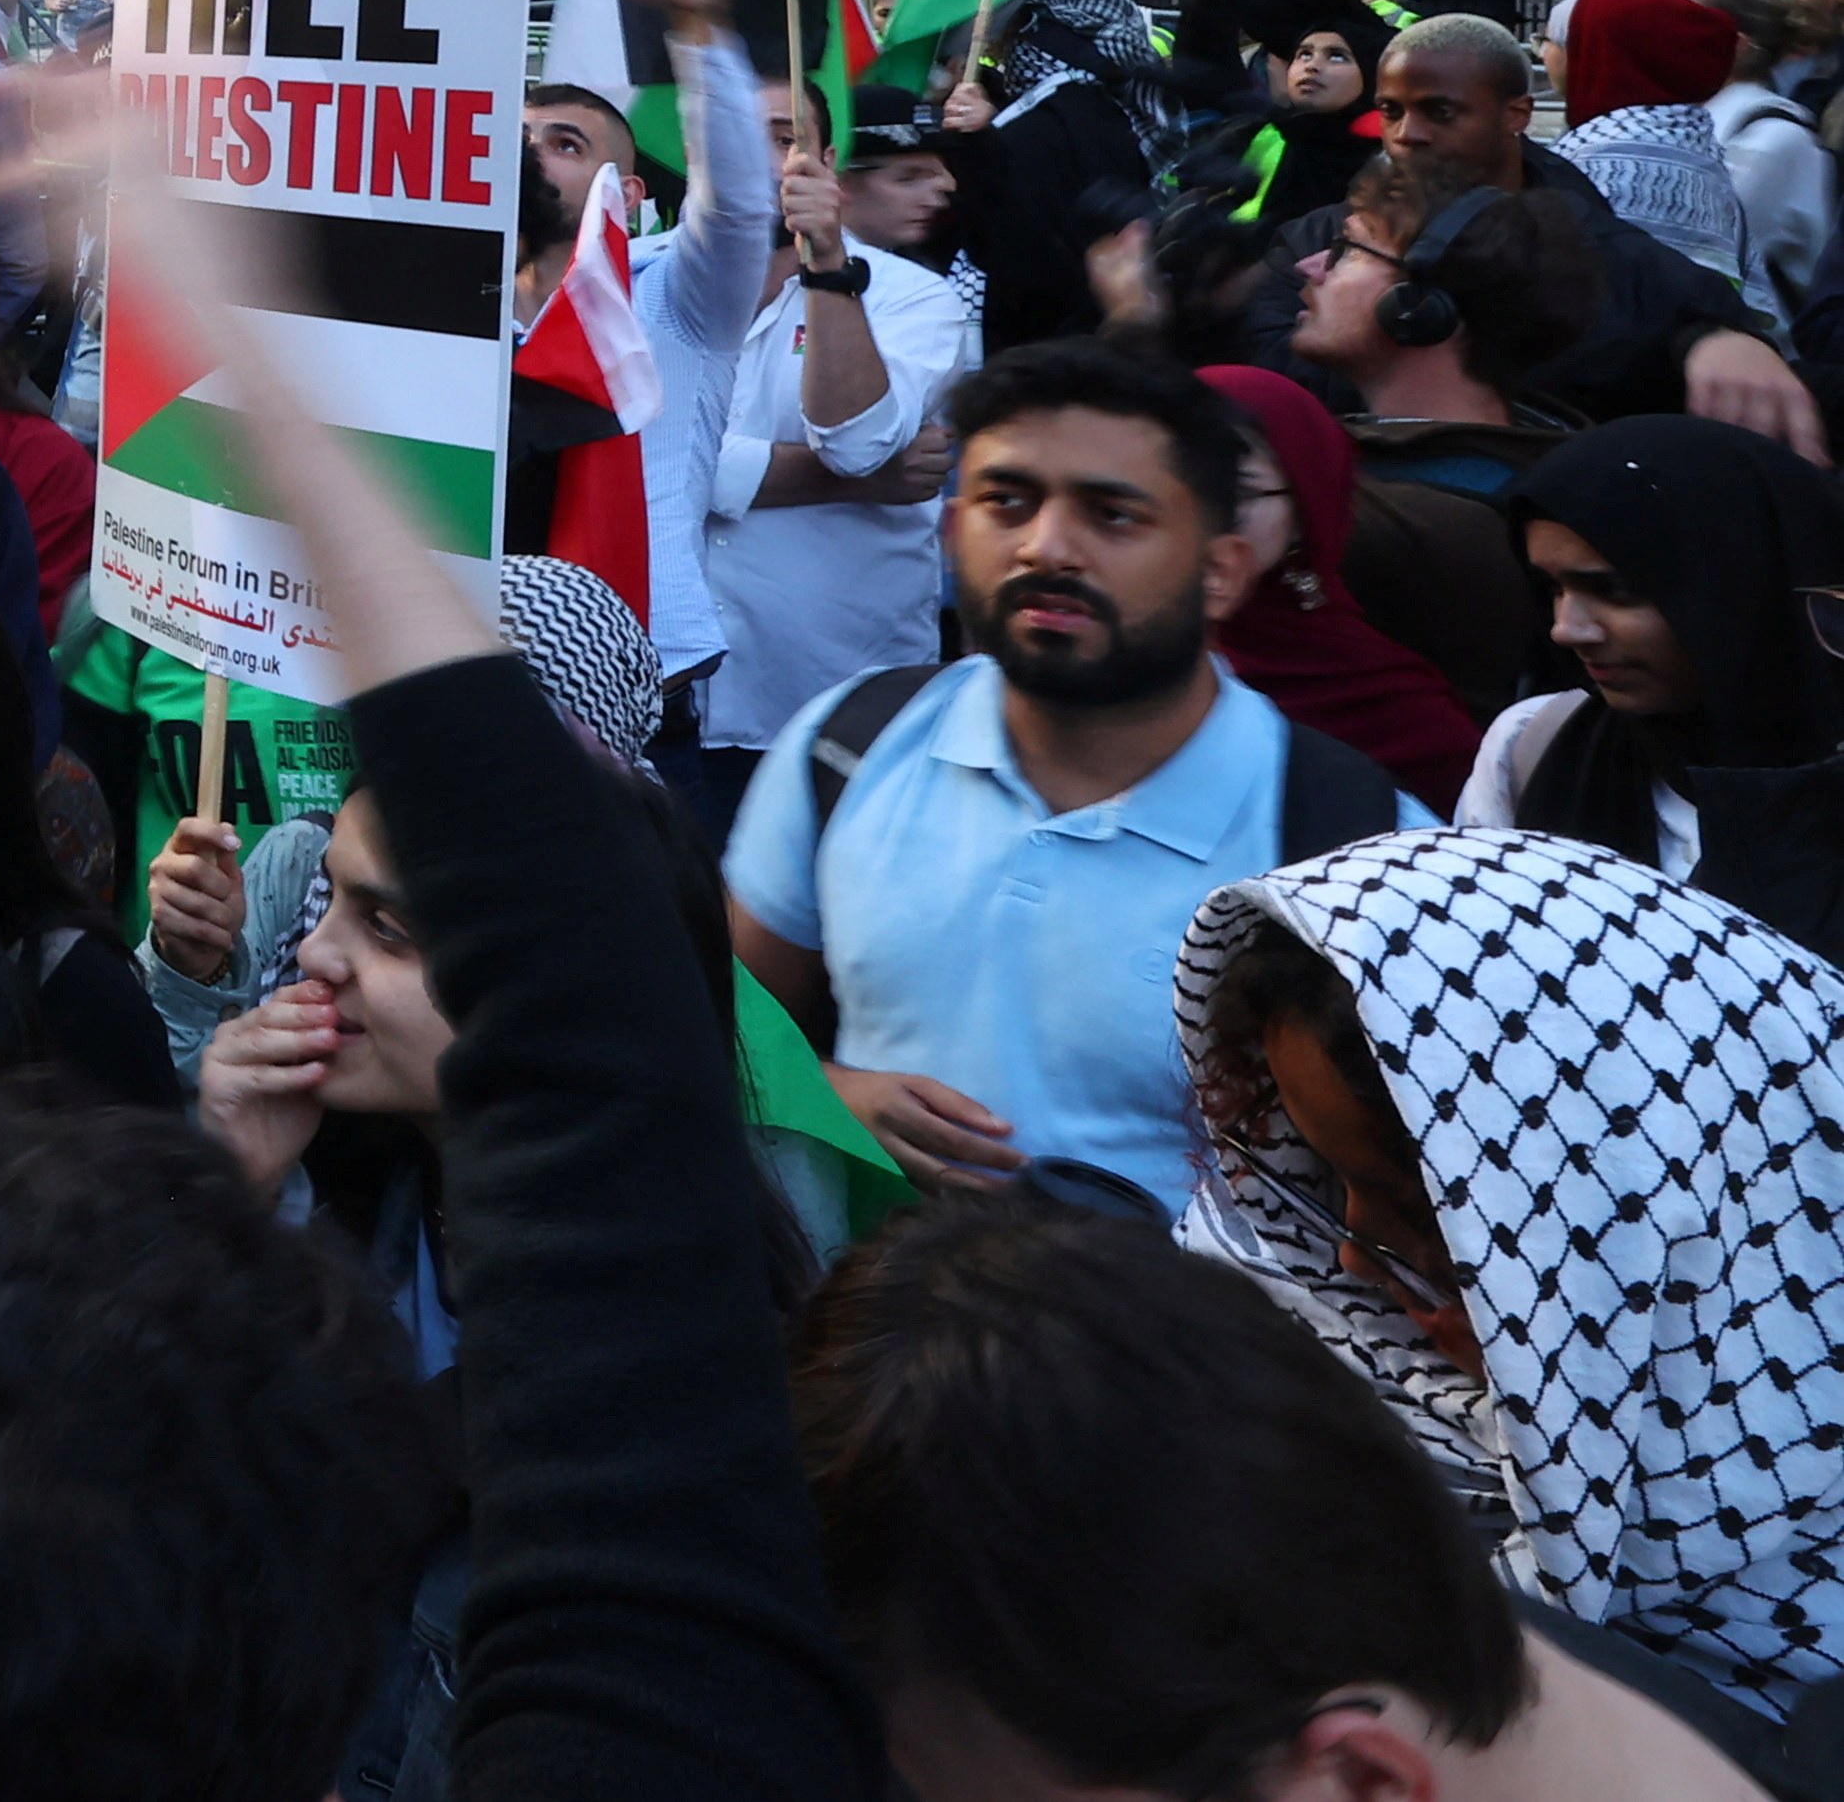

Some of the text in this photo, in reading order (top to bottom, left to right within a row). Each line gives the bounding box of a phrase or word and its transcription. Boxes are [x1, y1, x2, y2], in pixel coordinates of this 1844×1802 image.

[102, 545, 144, 595] بريطانيا
[103, 510, 164, 562] Palestine
[167, 538, 228, 585] Forum
[234, 561, 260, 595] in
[166, 587, 275, 633] الفلسطيني
[129, 603, 282, 677] www.palestinianforum.org.uk
[272, 720, 350, 745] FRIENDS
[277, 746, 356, 771] AL-AQSA
[278, 773, 339, 799] PEACE
